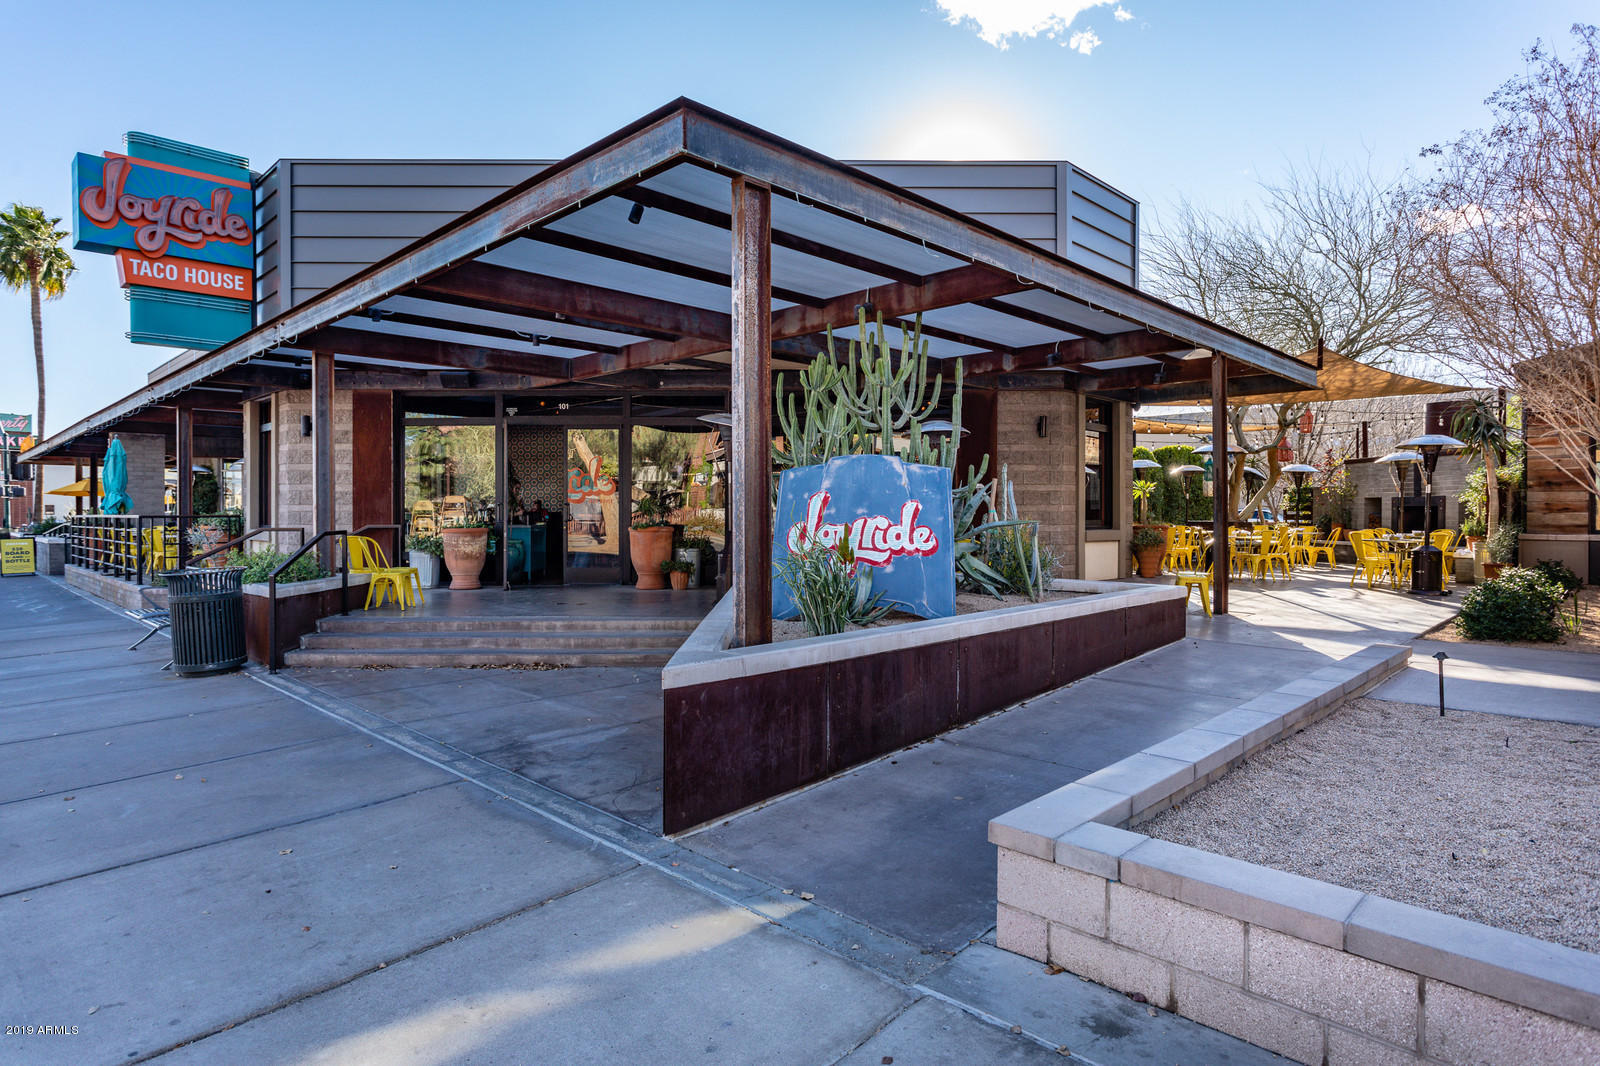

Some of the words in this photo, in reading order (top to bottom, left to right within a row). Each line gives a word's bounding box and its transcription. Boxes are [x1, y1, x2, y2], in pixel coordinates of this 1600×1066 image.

[80, 157, 252, 256] Joyride
[129, 258, 178, 281] TACO
[184, 267, 245, 291] HOUSE
